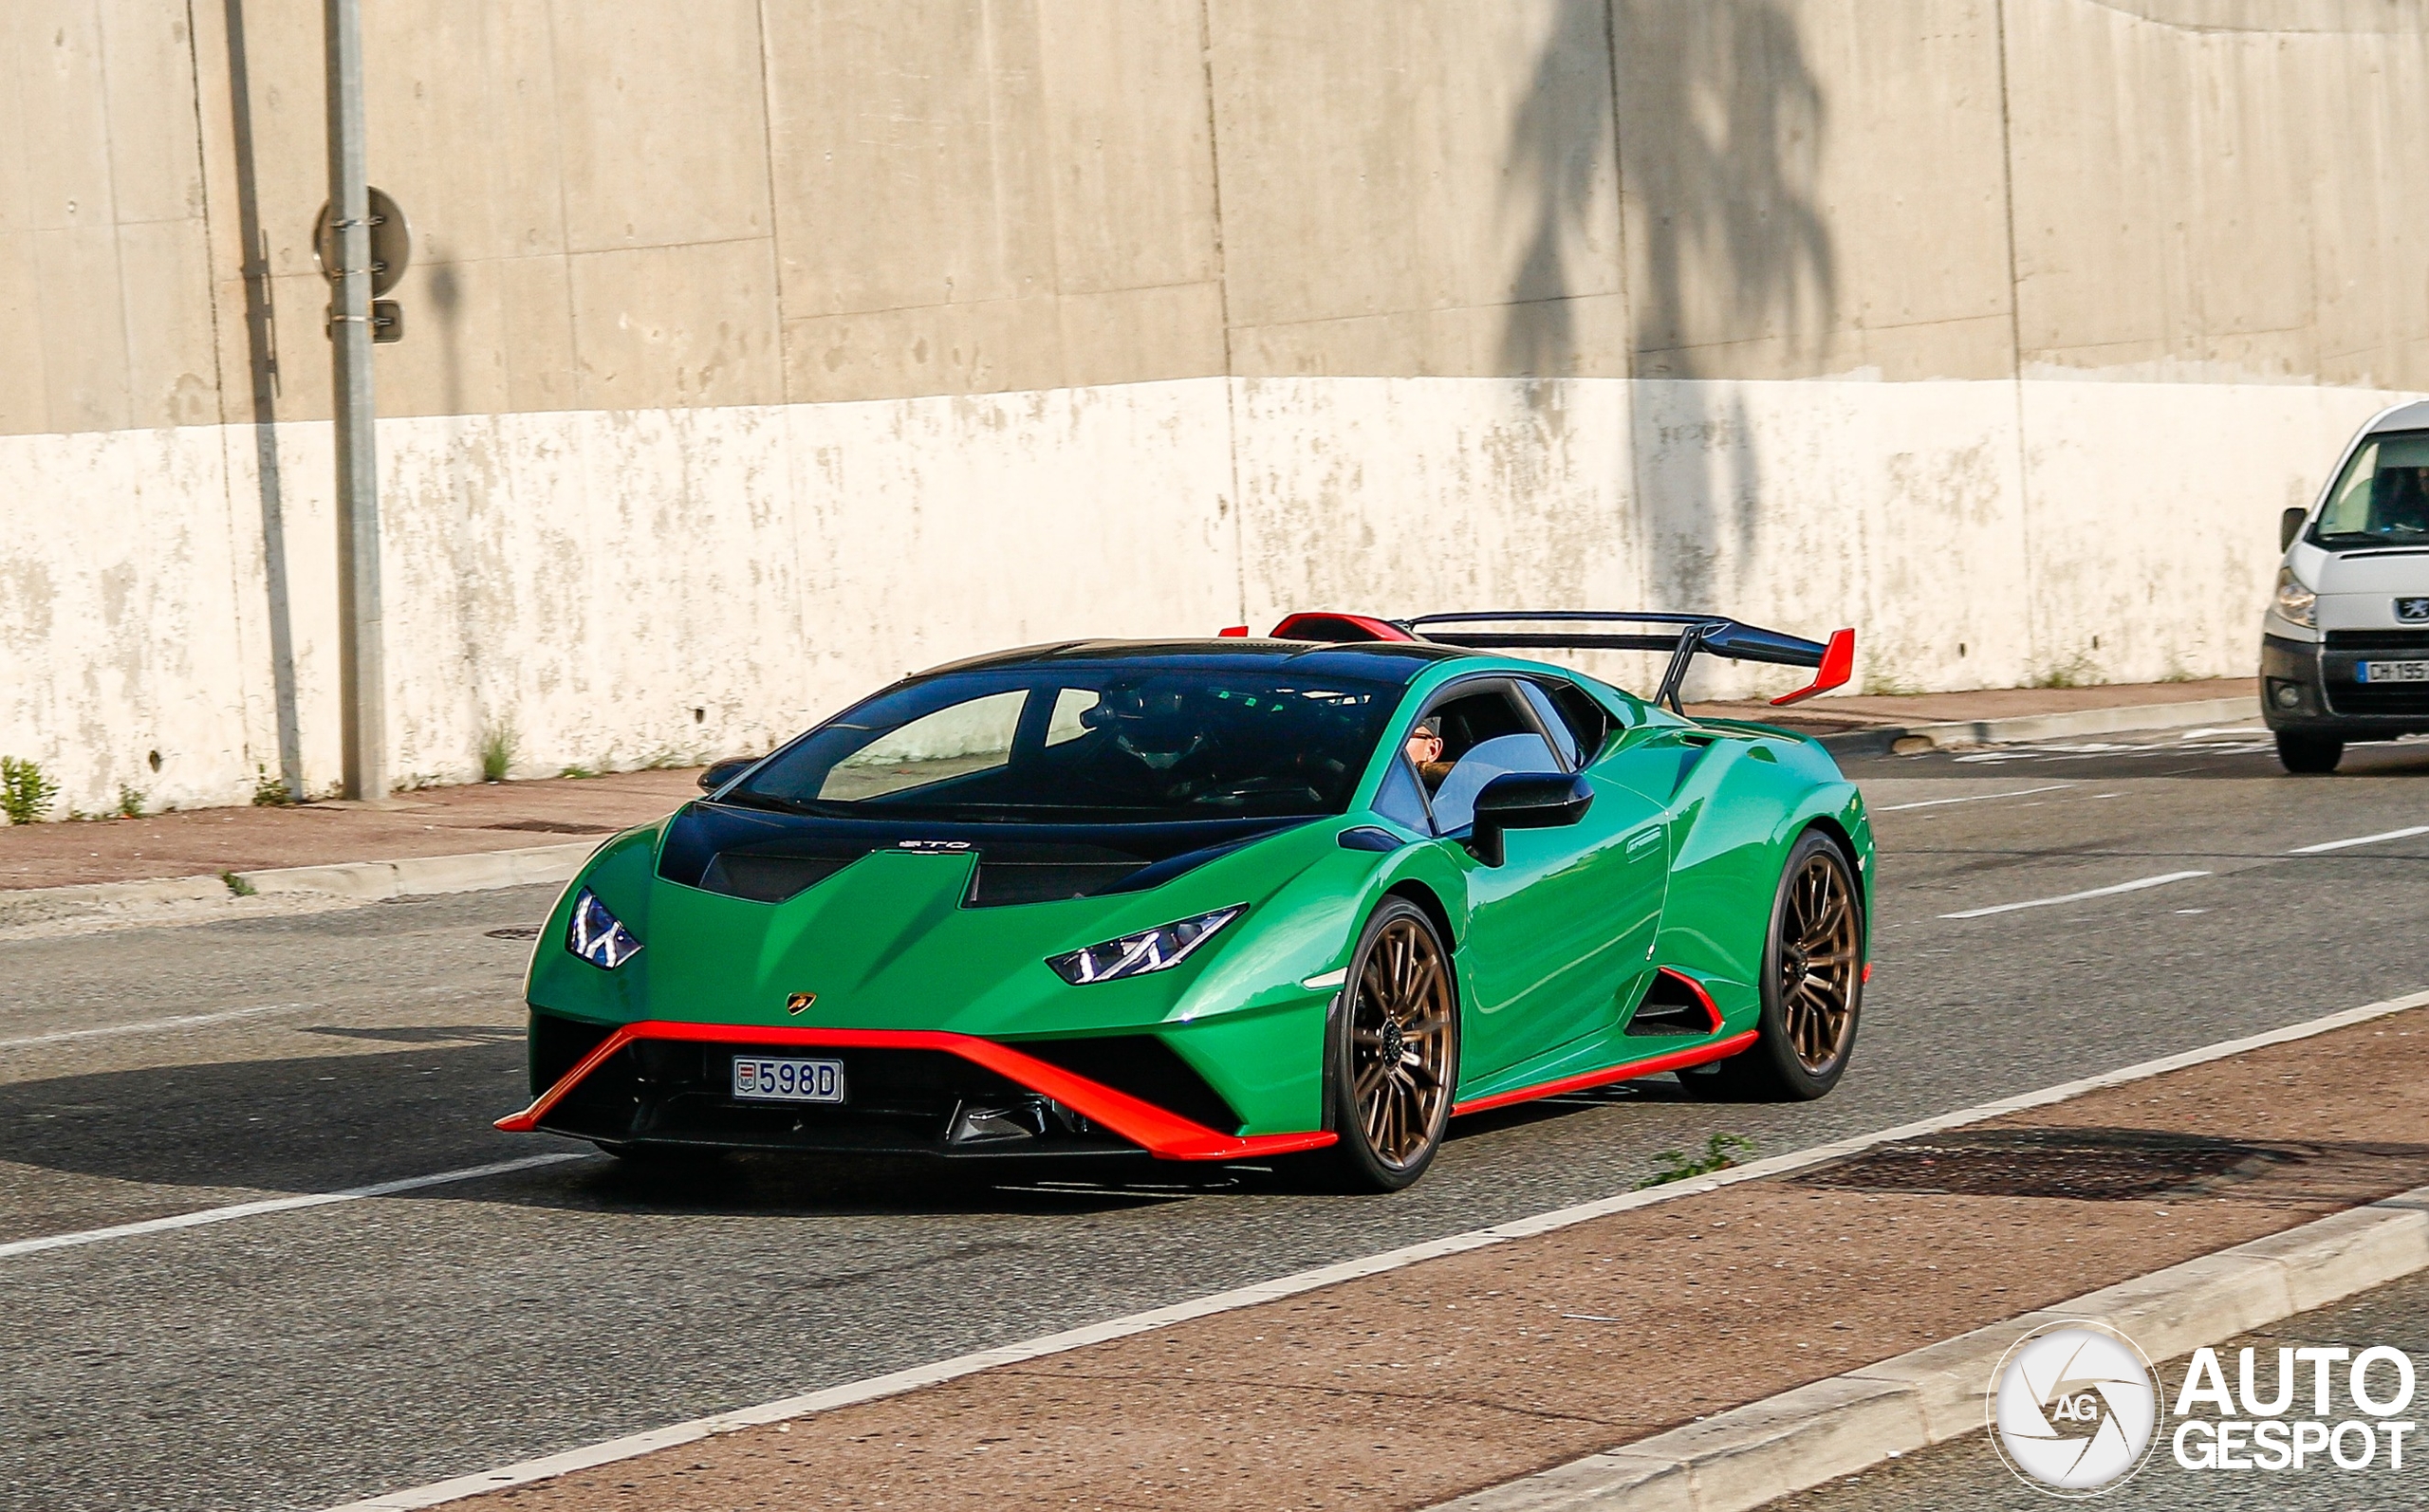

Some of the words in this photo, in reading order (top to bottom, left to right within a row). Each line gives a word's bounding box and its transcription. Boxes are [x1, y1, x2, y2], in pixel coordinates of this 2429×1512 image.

[899, 840, 971, 849] STO
[740, 1078, 752, 1087] MC
[760, 1062, 836, 1096] 598D
